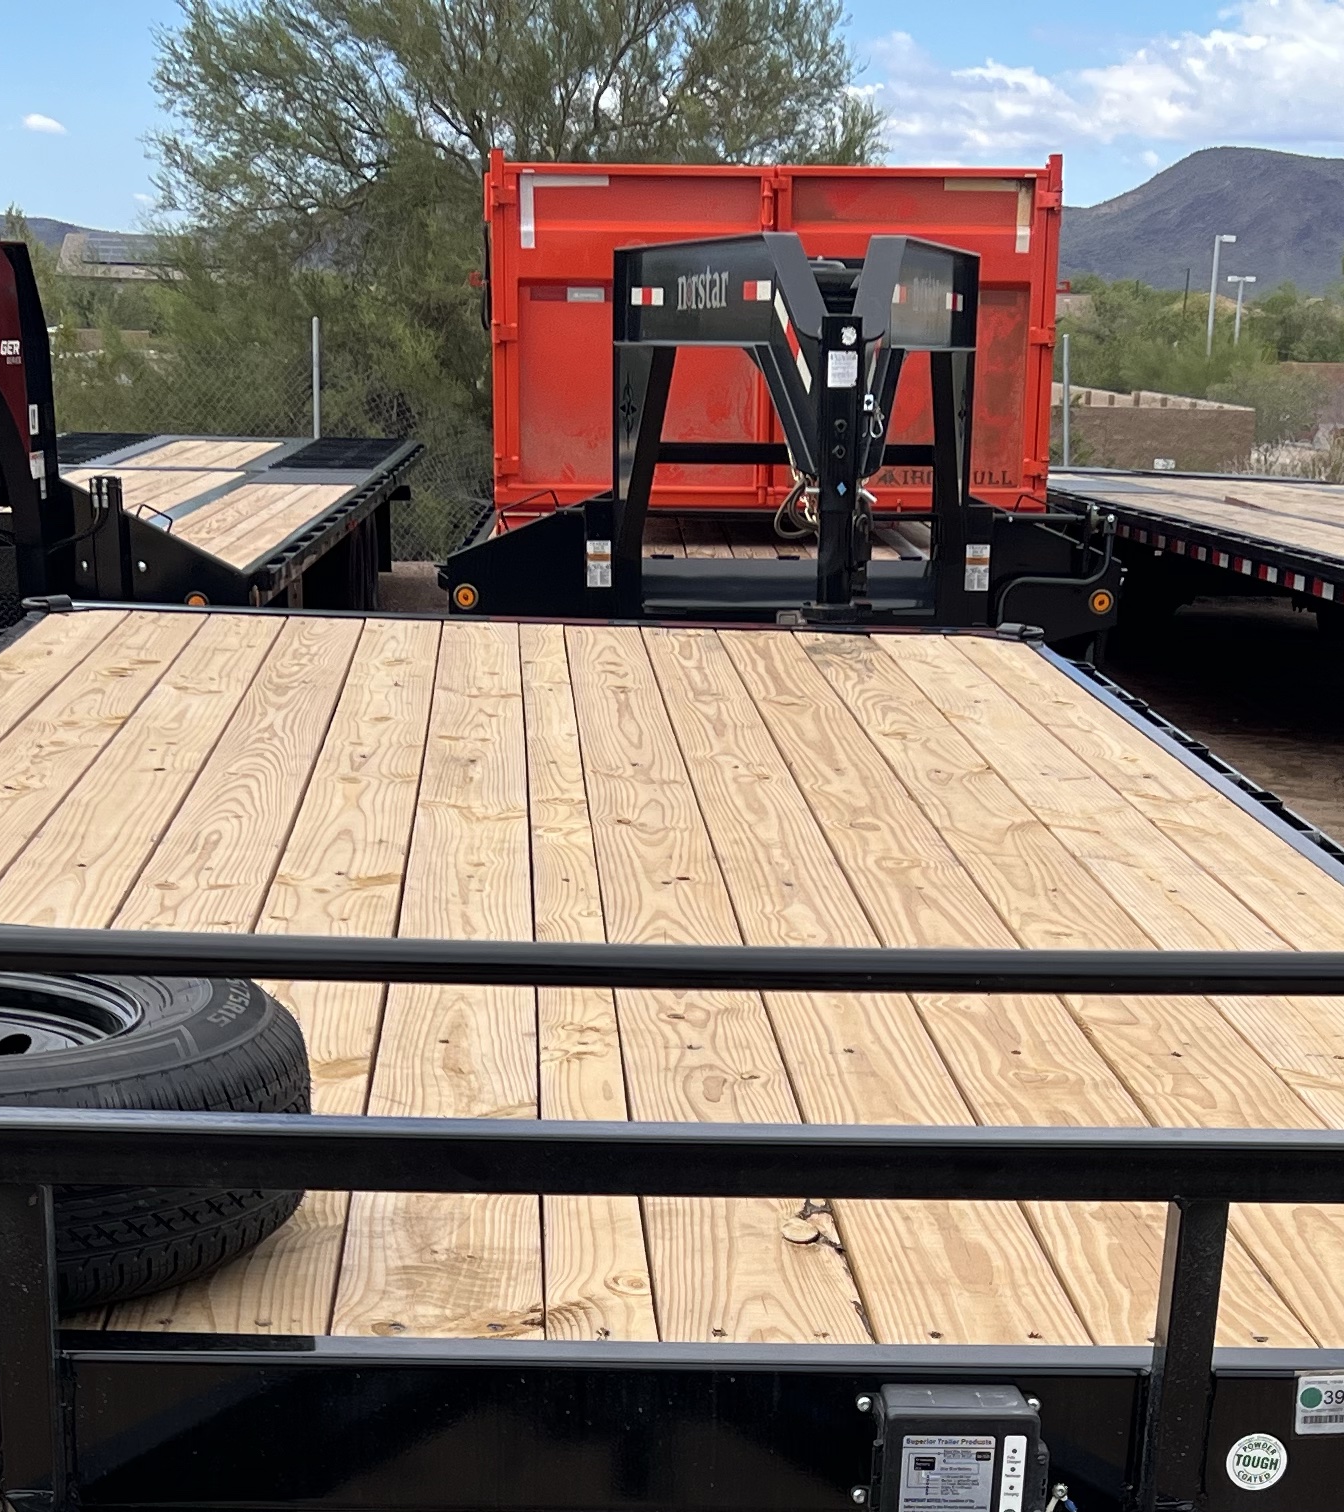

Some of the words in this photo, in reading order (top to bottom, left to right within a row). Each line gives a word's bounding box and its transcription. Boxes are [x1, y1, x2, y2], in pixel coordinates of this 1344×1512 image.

[906, 1438, 936, 1446] Superior
[1242, 1441, 1277, 1456] POWDER
[1235, 1453, 1279, 1471] TOUGH
[1237, 1470, 1271, 1483] COATED
